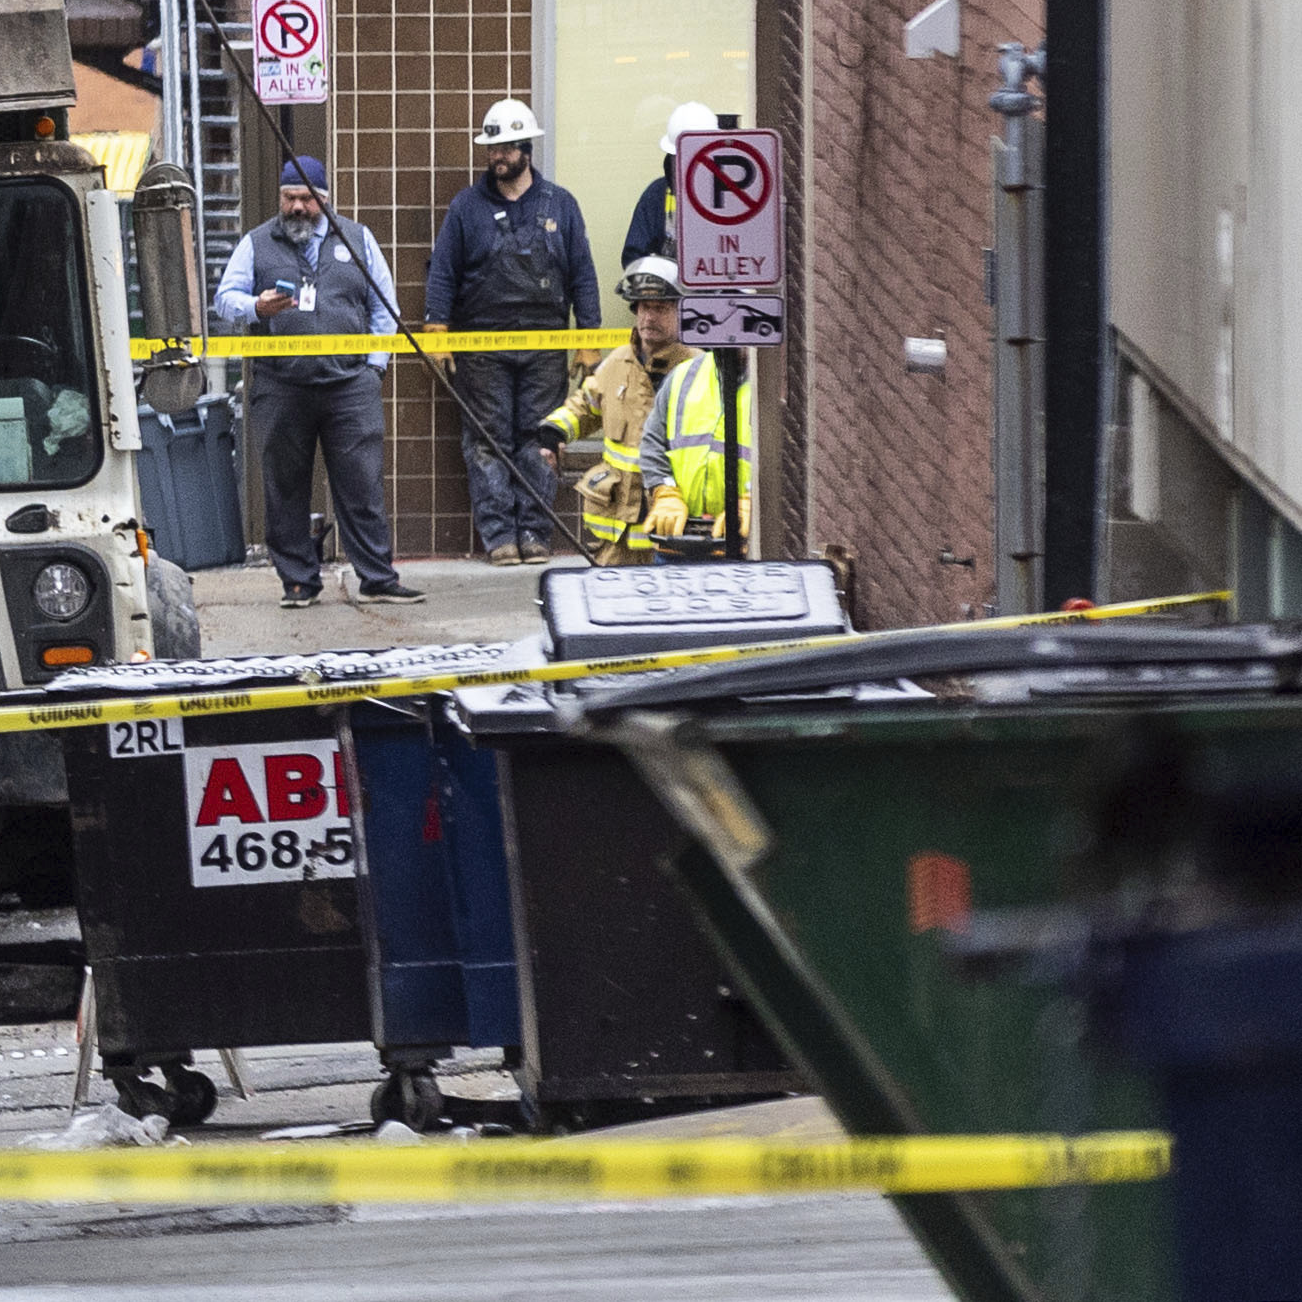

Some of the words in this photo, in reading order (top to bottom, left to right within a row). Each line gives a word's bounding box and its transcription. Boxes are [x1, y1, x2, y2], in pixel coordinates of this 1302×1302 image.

[286, 63, 299, 77] IN
[269, 77, 317, 92] ALLEY
[718, 234, 741, 254] IN
[695, 256, 766, 276] ALLEY
[114, 719, 183, 755] 2RL
